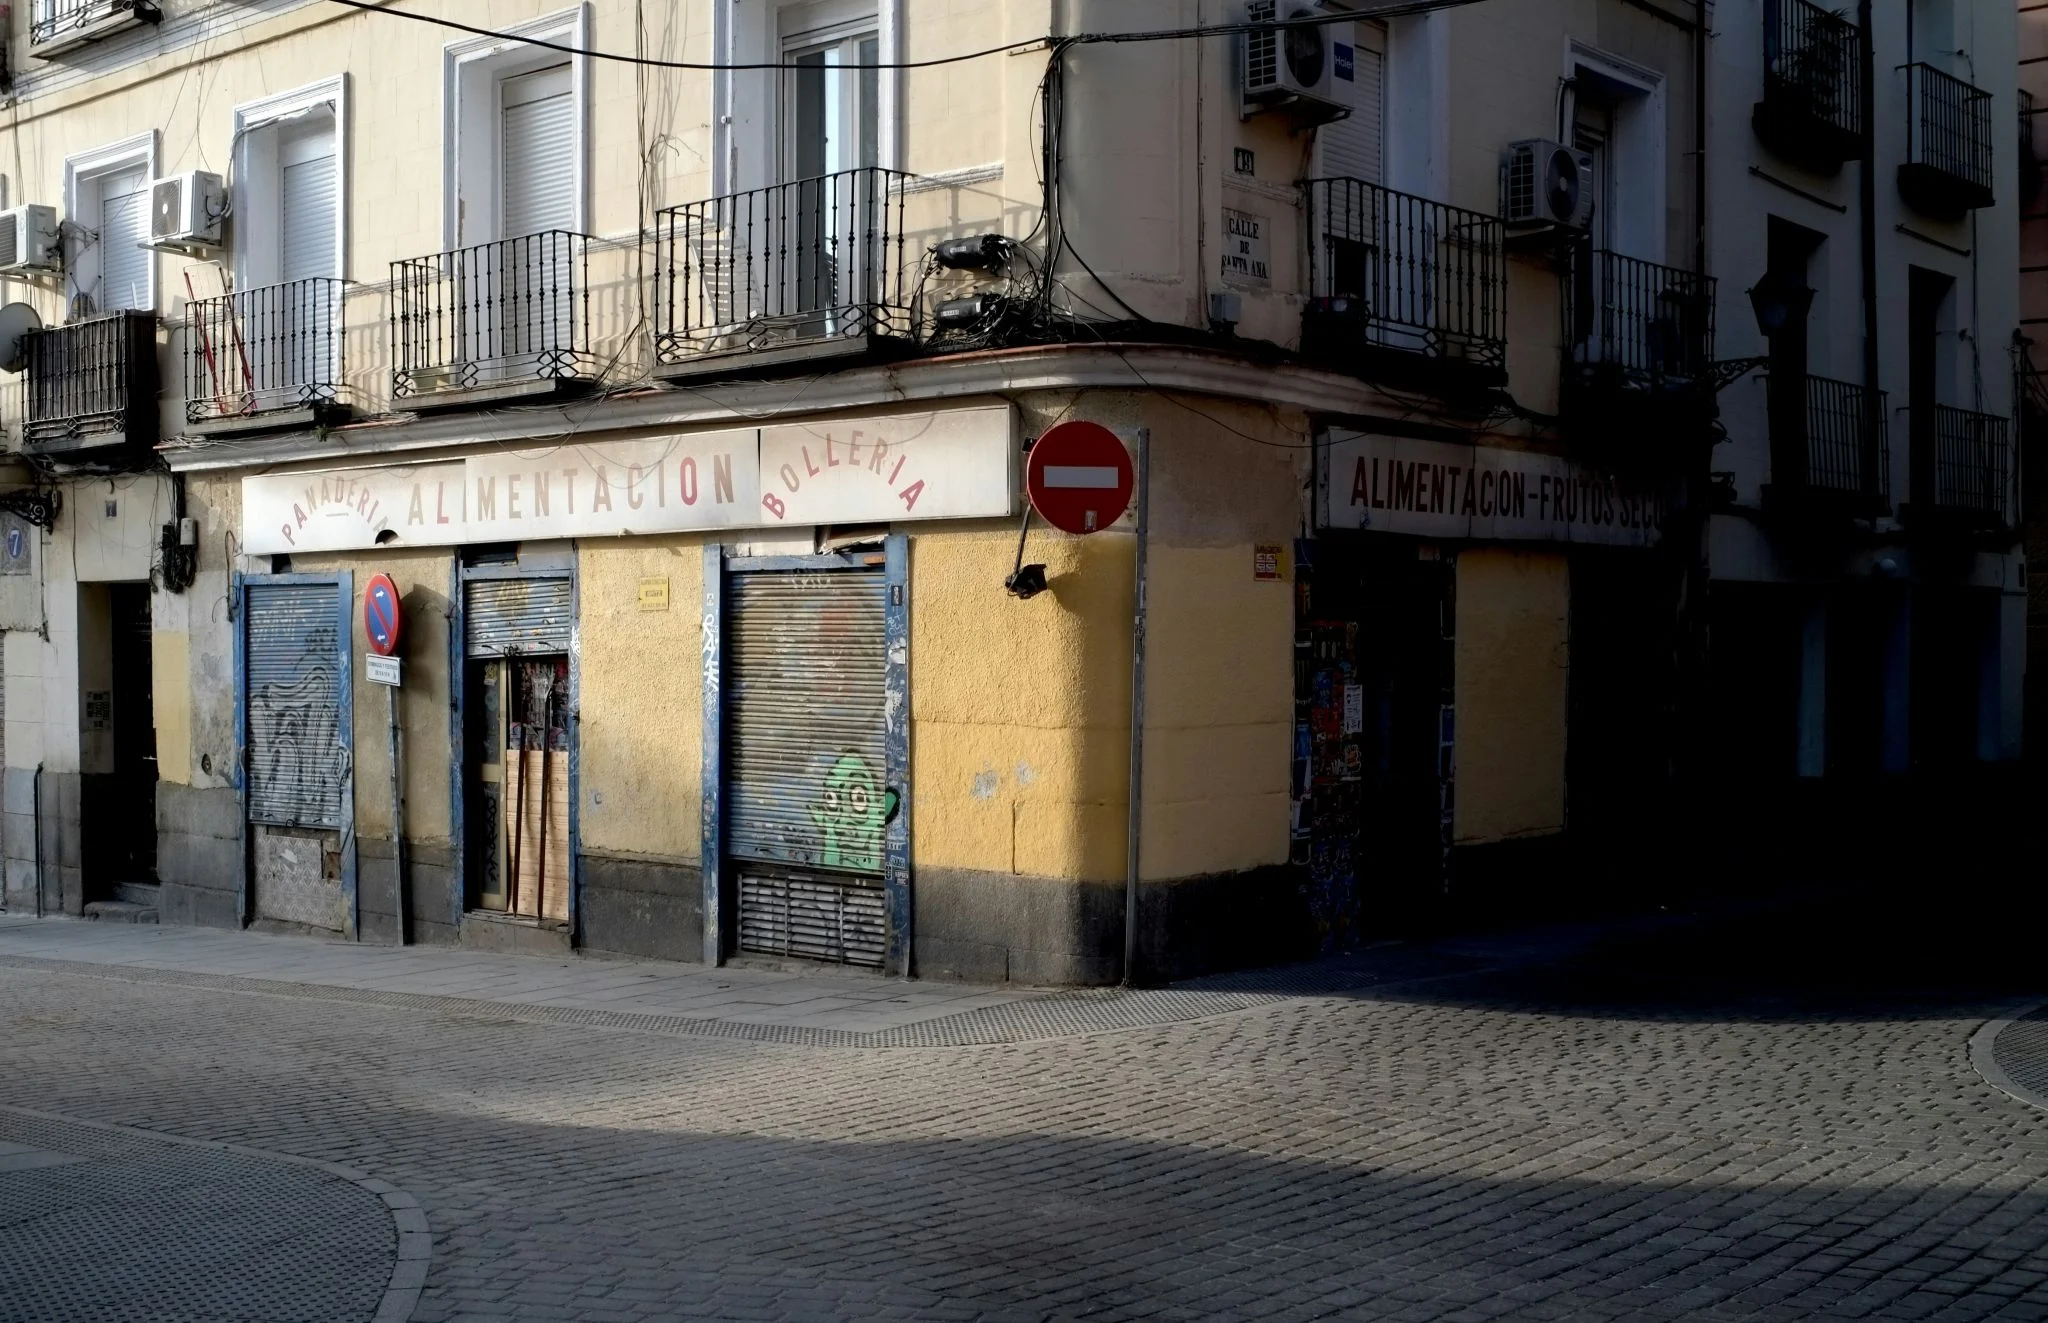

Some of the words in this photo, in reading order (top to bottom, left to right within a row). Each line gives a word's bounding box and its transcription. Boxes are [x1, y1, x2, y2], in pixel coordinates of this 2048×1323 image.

[1229, 218, 1259, 239] CALLE
[1240, 240, 1250, 254] DE
[1251, 259, 1268, 280] ANA
[282, 475, 389, 546] PANADERIA
[408, 453, 735, 526] ALIMENTACION
[762, 430, 925, 520] BOLLERIA
[9, 529, 20, 556] 7
